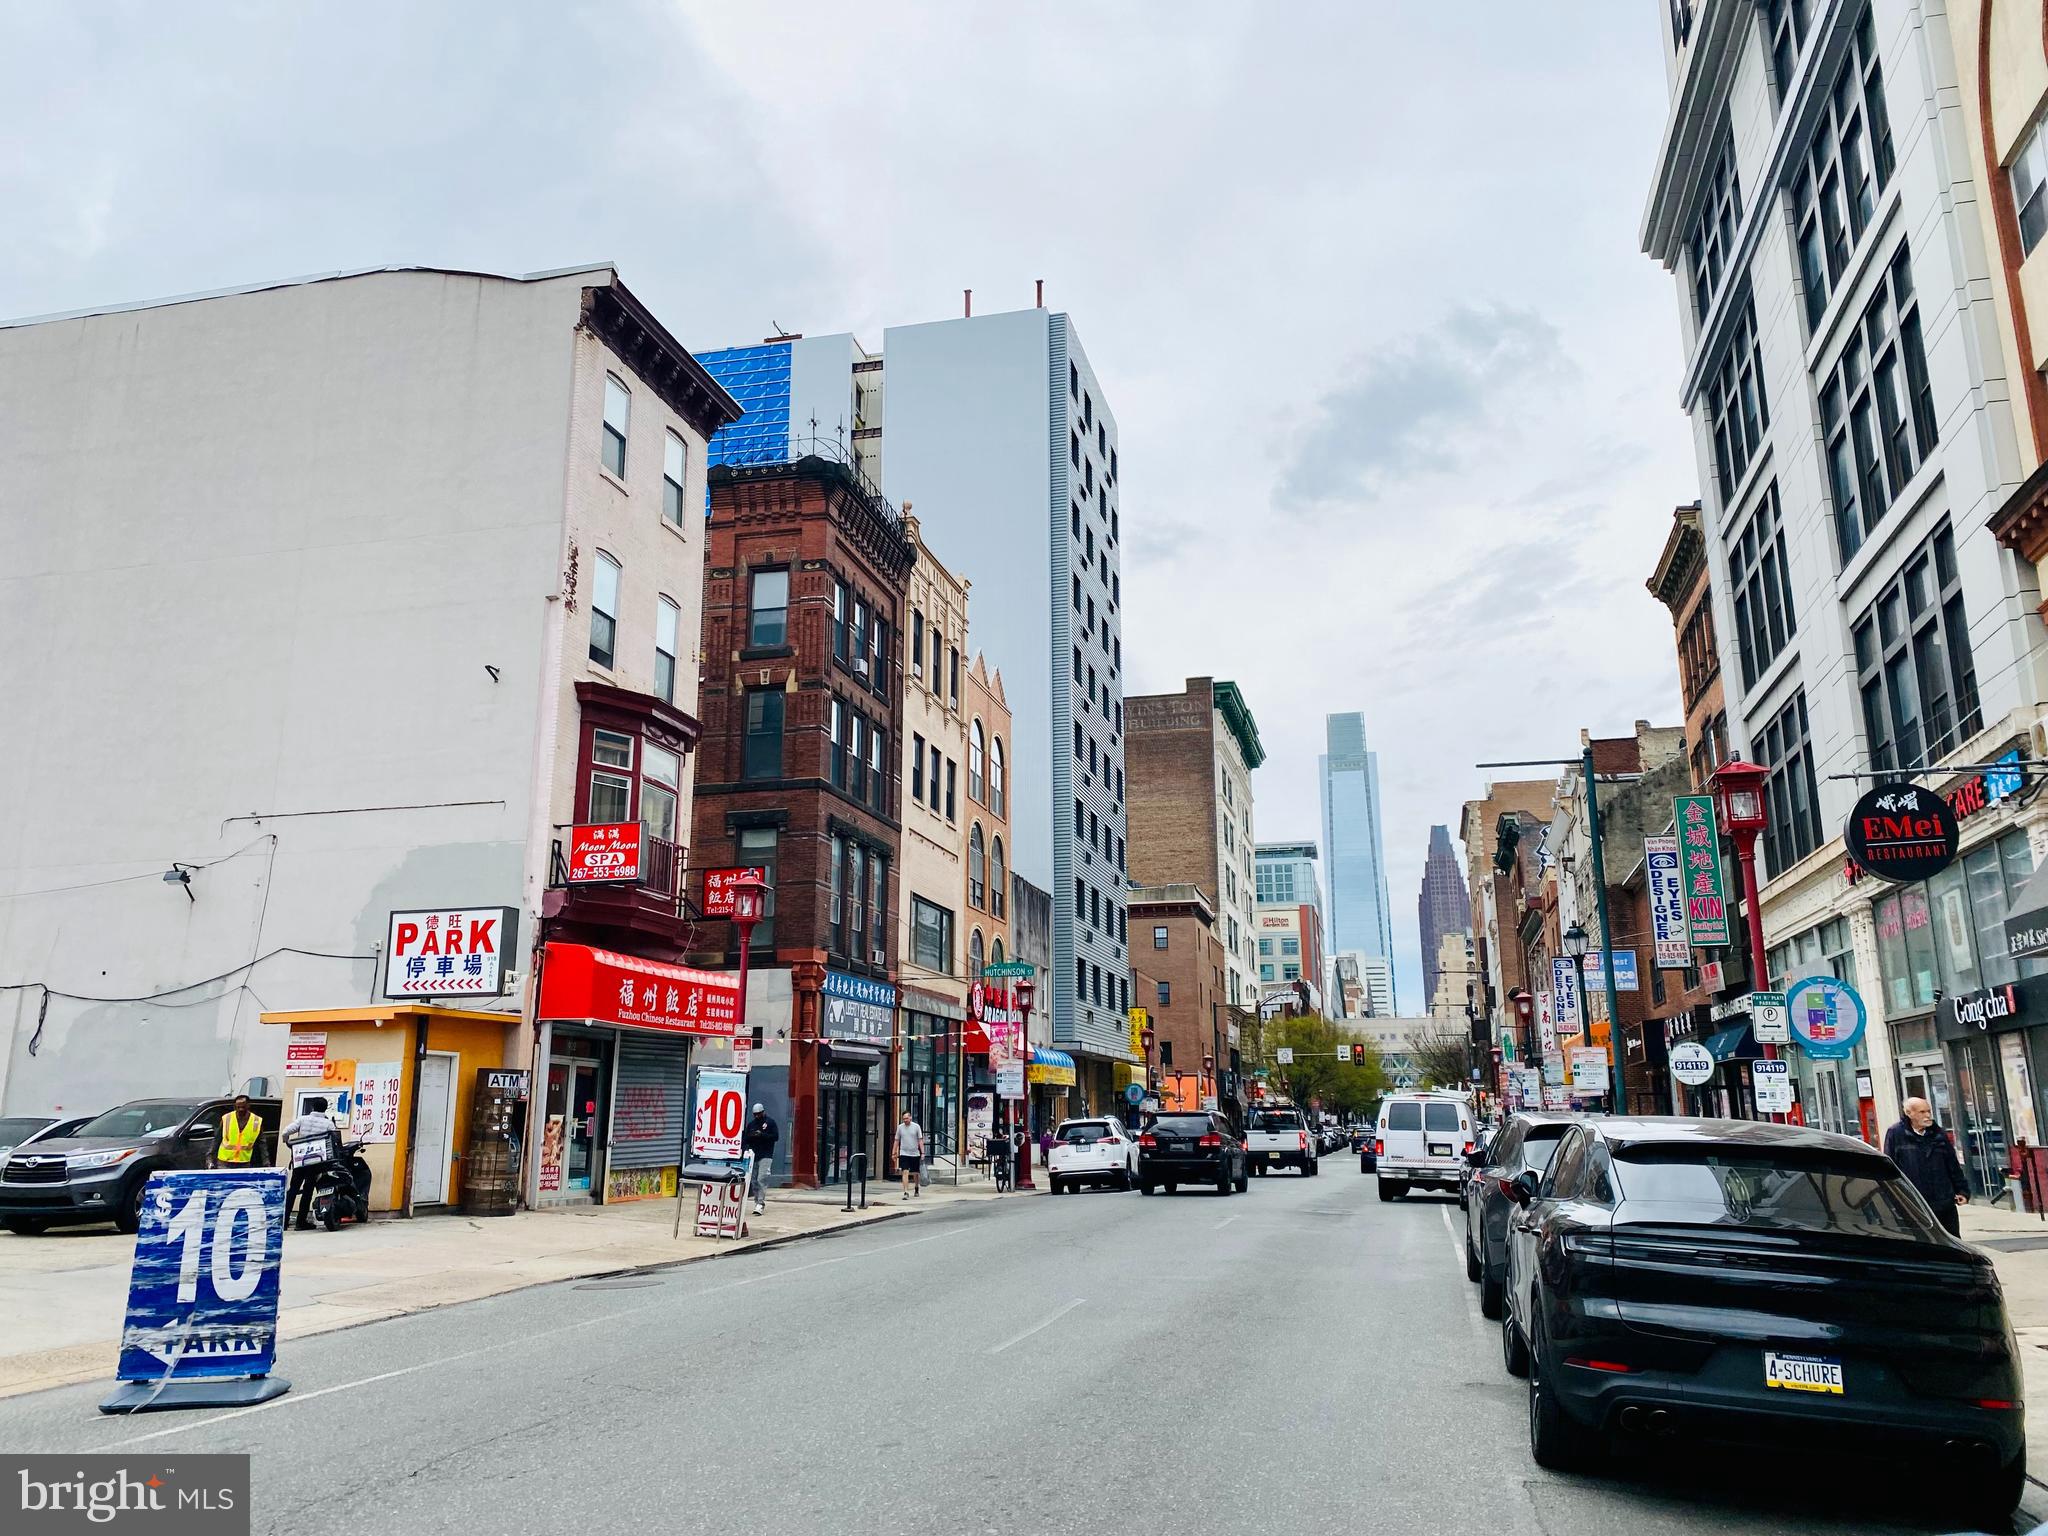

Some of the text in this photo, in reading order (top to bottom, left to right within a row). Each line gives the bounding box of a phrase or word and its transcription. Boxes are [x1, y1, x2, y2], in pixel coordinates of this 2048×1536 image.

[1863, 814, 1944, 840] EMei
[574, 840, 637, 855] Moon Moon
[1684, 800, 1716, 895] 金城地產
[1867, 844, 1948, 860] RESTAURANT
[590, 854, 620, 864] SPA
[572, 866, 636, 878] 267-553-6988
[1651, 870, 1669, 940] DESIGNER
[1667, 878, 1682, 921] EYES
[1690, 897, 1722, 920] KIN
[396, 920, 496, 956] PARK
[406, 954, 482, 978] 停車場
[985, 968, 1026, 976] HUTCHINSON
[619, 979, 698, 1017] 福州飯店
[1555, 970, 1565, 1022] DESIGNER
[1566, 976, 1575, 1008] EYES
[1767, 1009, 1773, 1018] P
[1954, 989, 2008, 1030] Gong cha
[618, 1008, 696, 1028] Fuzhou Chinese Restaurant
[1676, 1062, 1707, 1070] 914119
[1756, 1064, 1785, 1072] 914119
[364, 1080, 375, 1091] HR
[490, 1075, 519, 1087] ATM
[818, 1069, 837, 1086] iberty
[840, 1071, 861, 1087] Liberty
[363, 1094, 374, 1105] HR
[356, 1110, 360, 1121] 3
[361, 1109, 372, 1121] HR
[352, 1124, 362, 1135] ALL
[694, 1136, 741, 1146] PARKING
[1783, 1354, 1822, 1362] PENNSYLVANIA
